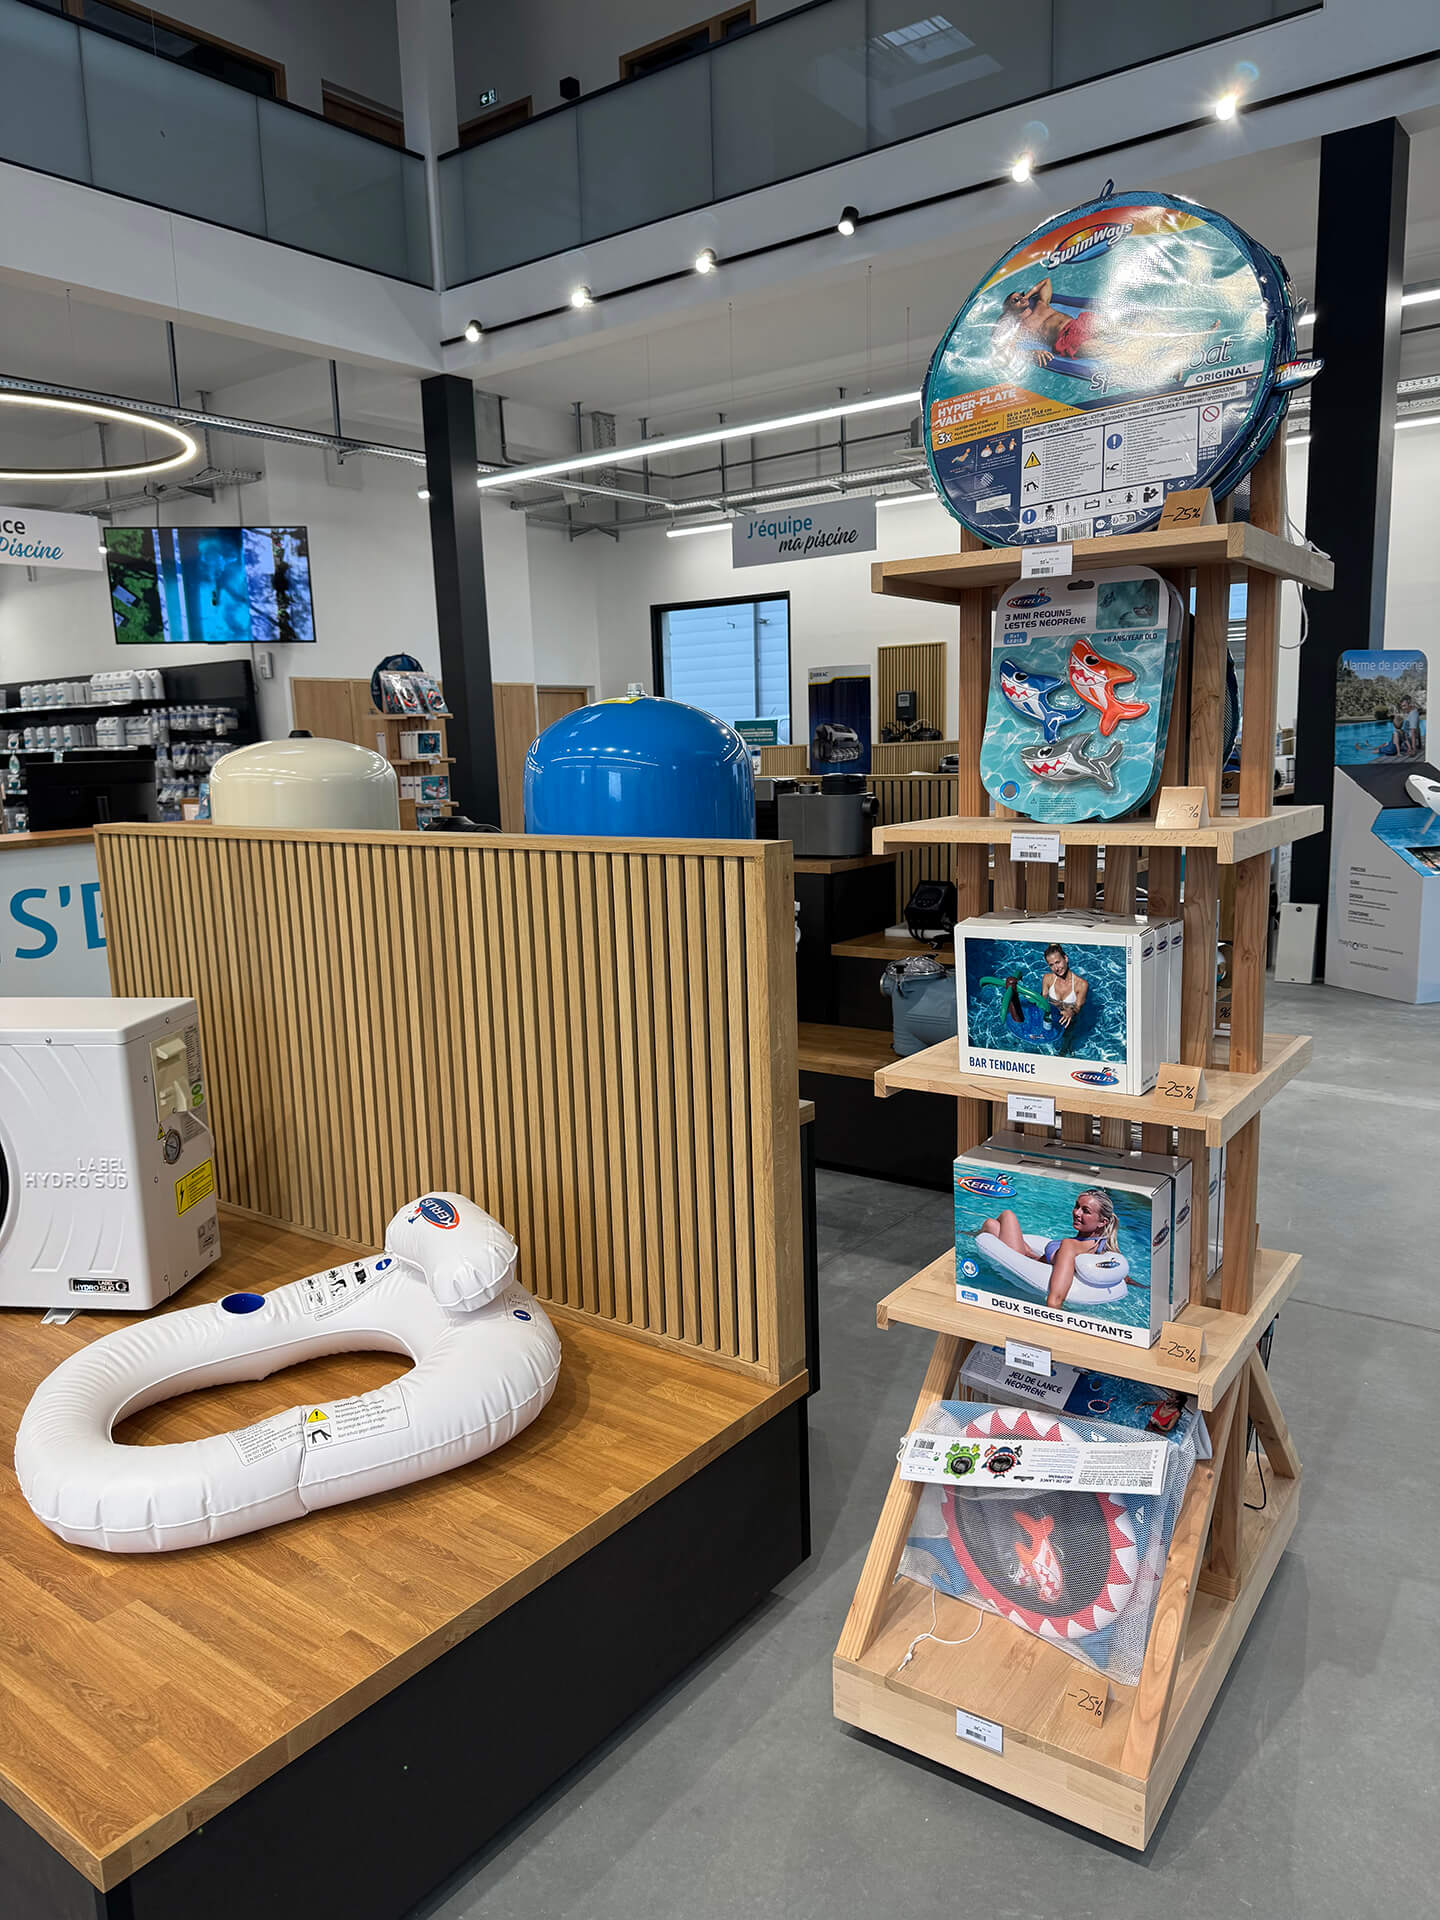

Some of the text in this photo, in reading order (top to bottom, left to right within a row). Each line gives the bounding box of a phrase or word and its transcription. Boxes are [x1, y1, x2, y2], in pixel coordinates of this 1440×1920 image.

[1047, 223, 1134, 270] SwimWays
[1195, 366, 1249, 383] ORIGINAL
[1275, 359, 1322, 383] imWays
[938, 388, 1017, 418] HYPER-FLATE
[939, 409, 974, 428] VALVE
[937, 432, 953, 445] 3x
[1163, 506, 1201, 522] -25%
[0, 519, 26, 535] ce
[747, 515, 813, 539] J'équipe
[778, 526, 859, 554] ma piscine
[1004, 616, 1087, 630] LESTES NEOPRENE
[1012, 612, 1032, 621] MINI
[1033, 608, 1072, 620] REQUINS
[1343, 660, 1377, 671] Alarme
[1378, 659, 1392, 671] de
[969, 1056, 1036, 1074] BAR TENDANCE
[1072, 1071, 1115, 1083] KERLIS
[1158, 1081, 1195, 1099] -25%
[77, 1157, 127, 1173] LABEL
[24, 1172, 128, 1190] HYDRO SUD
[960, 1179, 1011, 1194] KERLIS
[423, 1199, 457, 1227] KERLIS
[991, 1298, 1133, 1340] DEUX SIEGES FLOTTANTS
[1159, 1341, 1196, 1363] -25%
[1004, 1378, 1047, 1398] NEOPRENE
[1008, 1371, 1063, 1394] JEU DE LANCE
[1067, 1688, 1103, 1716] -25%
